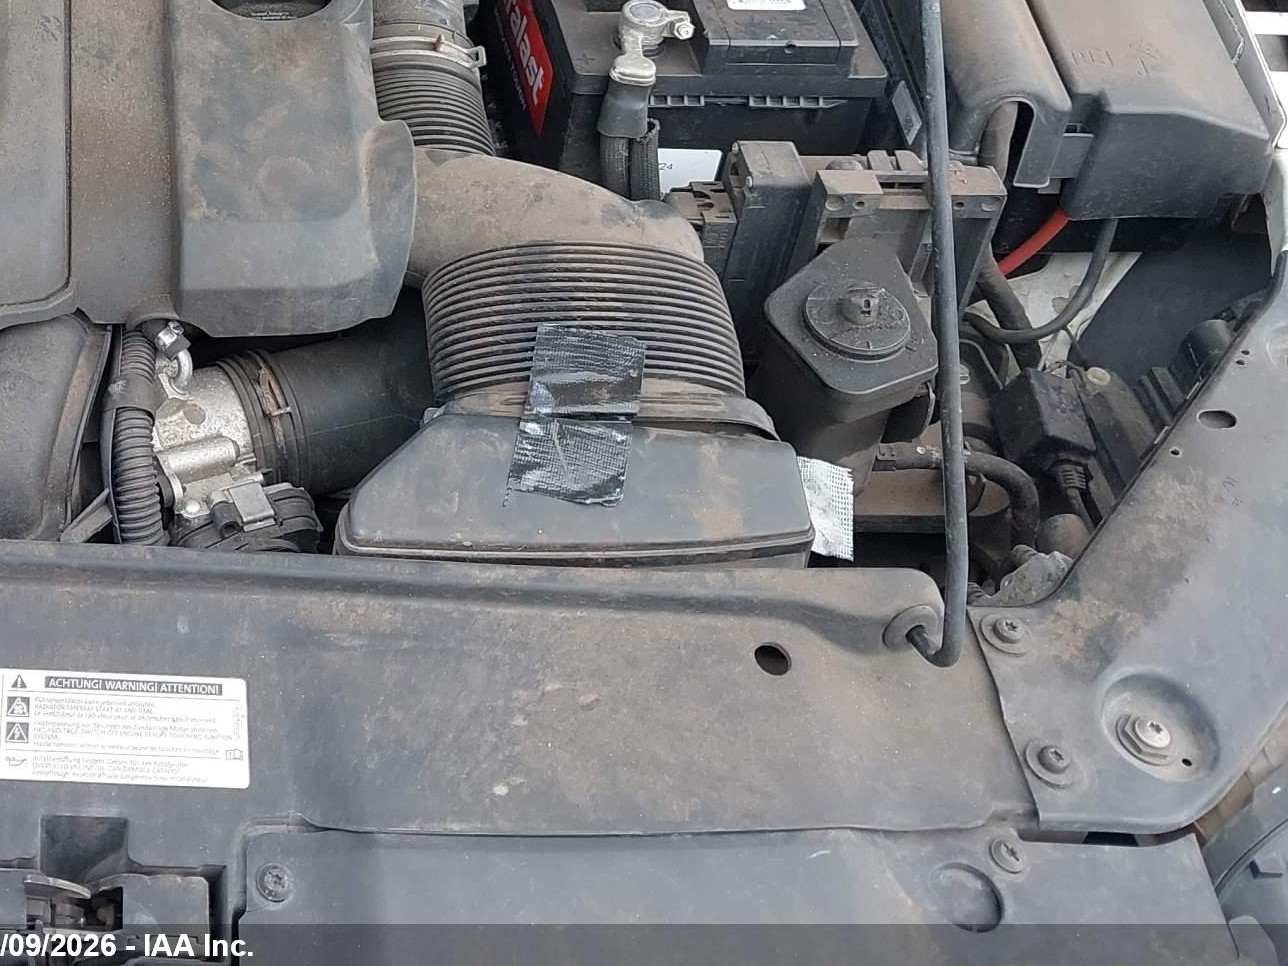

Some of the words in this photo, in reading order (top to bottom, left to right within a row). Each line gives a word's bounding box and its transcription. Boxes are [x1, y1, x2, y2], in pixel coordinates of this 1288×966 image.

[48, 677, 102, 690] ACHTUNG!
[105, 680, 158, 693] WARNING!
[159, 683, 219, 696] ATTENTION!
